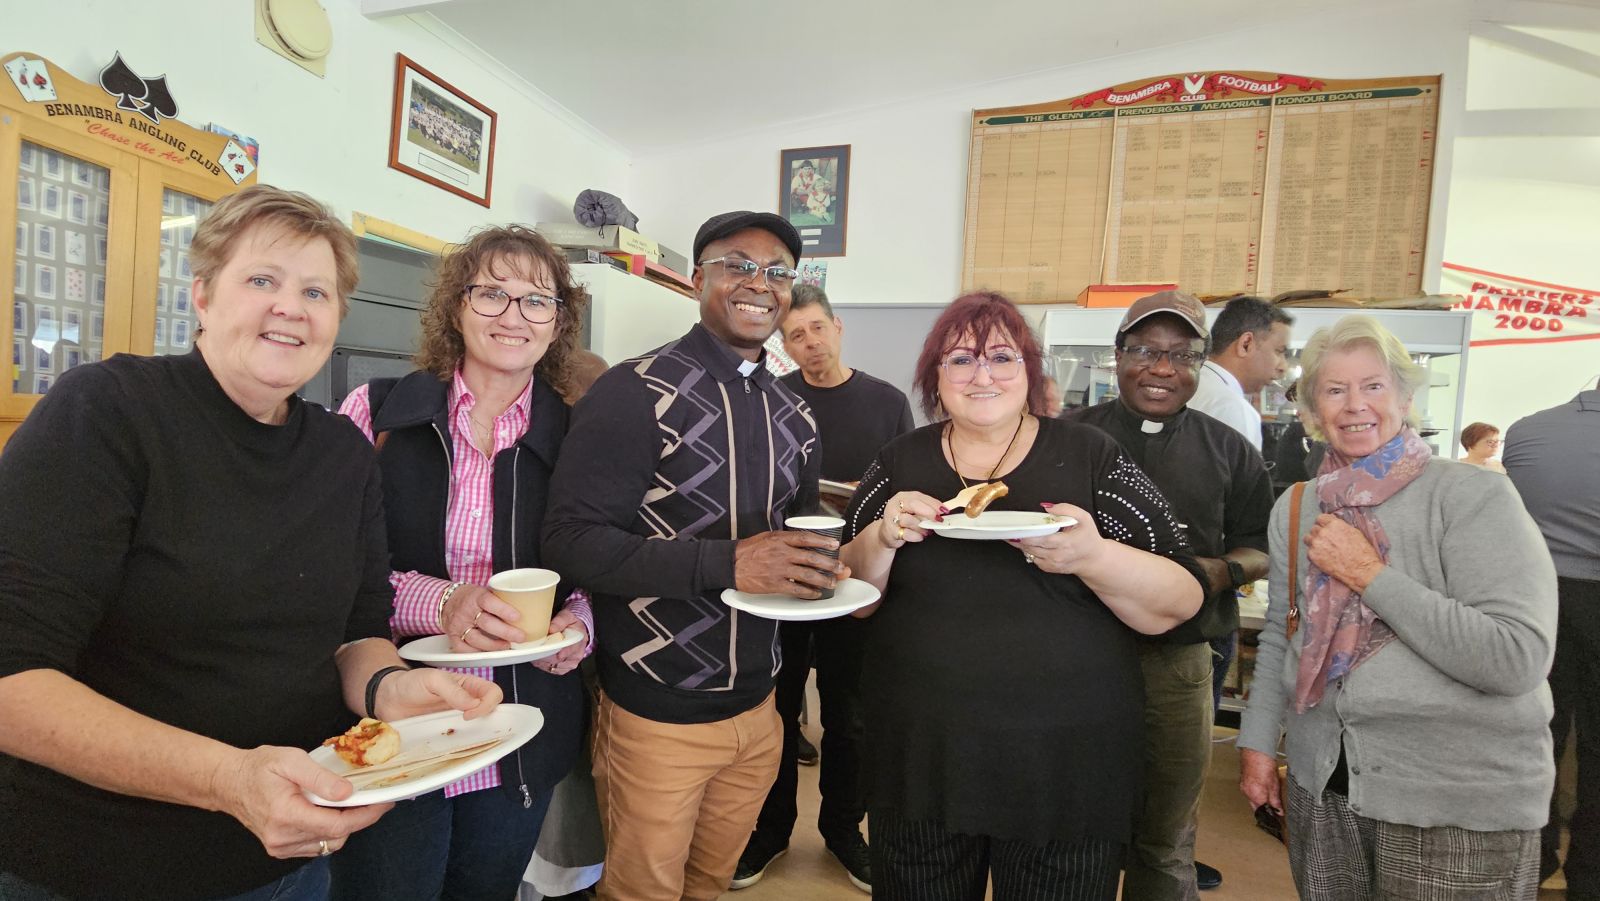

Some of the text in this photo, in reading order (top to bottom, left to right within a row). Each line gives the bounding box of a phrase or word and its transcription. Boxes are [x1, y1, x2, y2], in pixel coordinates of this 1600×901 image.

[1107, 75, 1283, 103] BENAMBRA FOOTBALL
[1180, 94, 1207, 102] CLUB
[1024, 115, 1044, 123] THE
[1048, 112, 1084, 122] GLENN
[1118, 104, 1194, 116] PRENDERGAST
[1200, 99, 1263, 111] MEMORIAL
[1277, 95, 1326, 105] HONOUR
[1329, 91, 1372, 100] BOARD
[45, 103, 221, 177] BENAMBRA ANGLING CLUB
[134, 137, 156, 155] the
[1494, 314, 1564, 332] 2000
